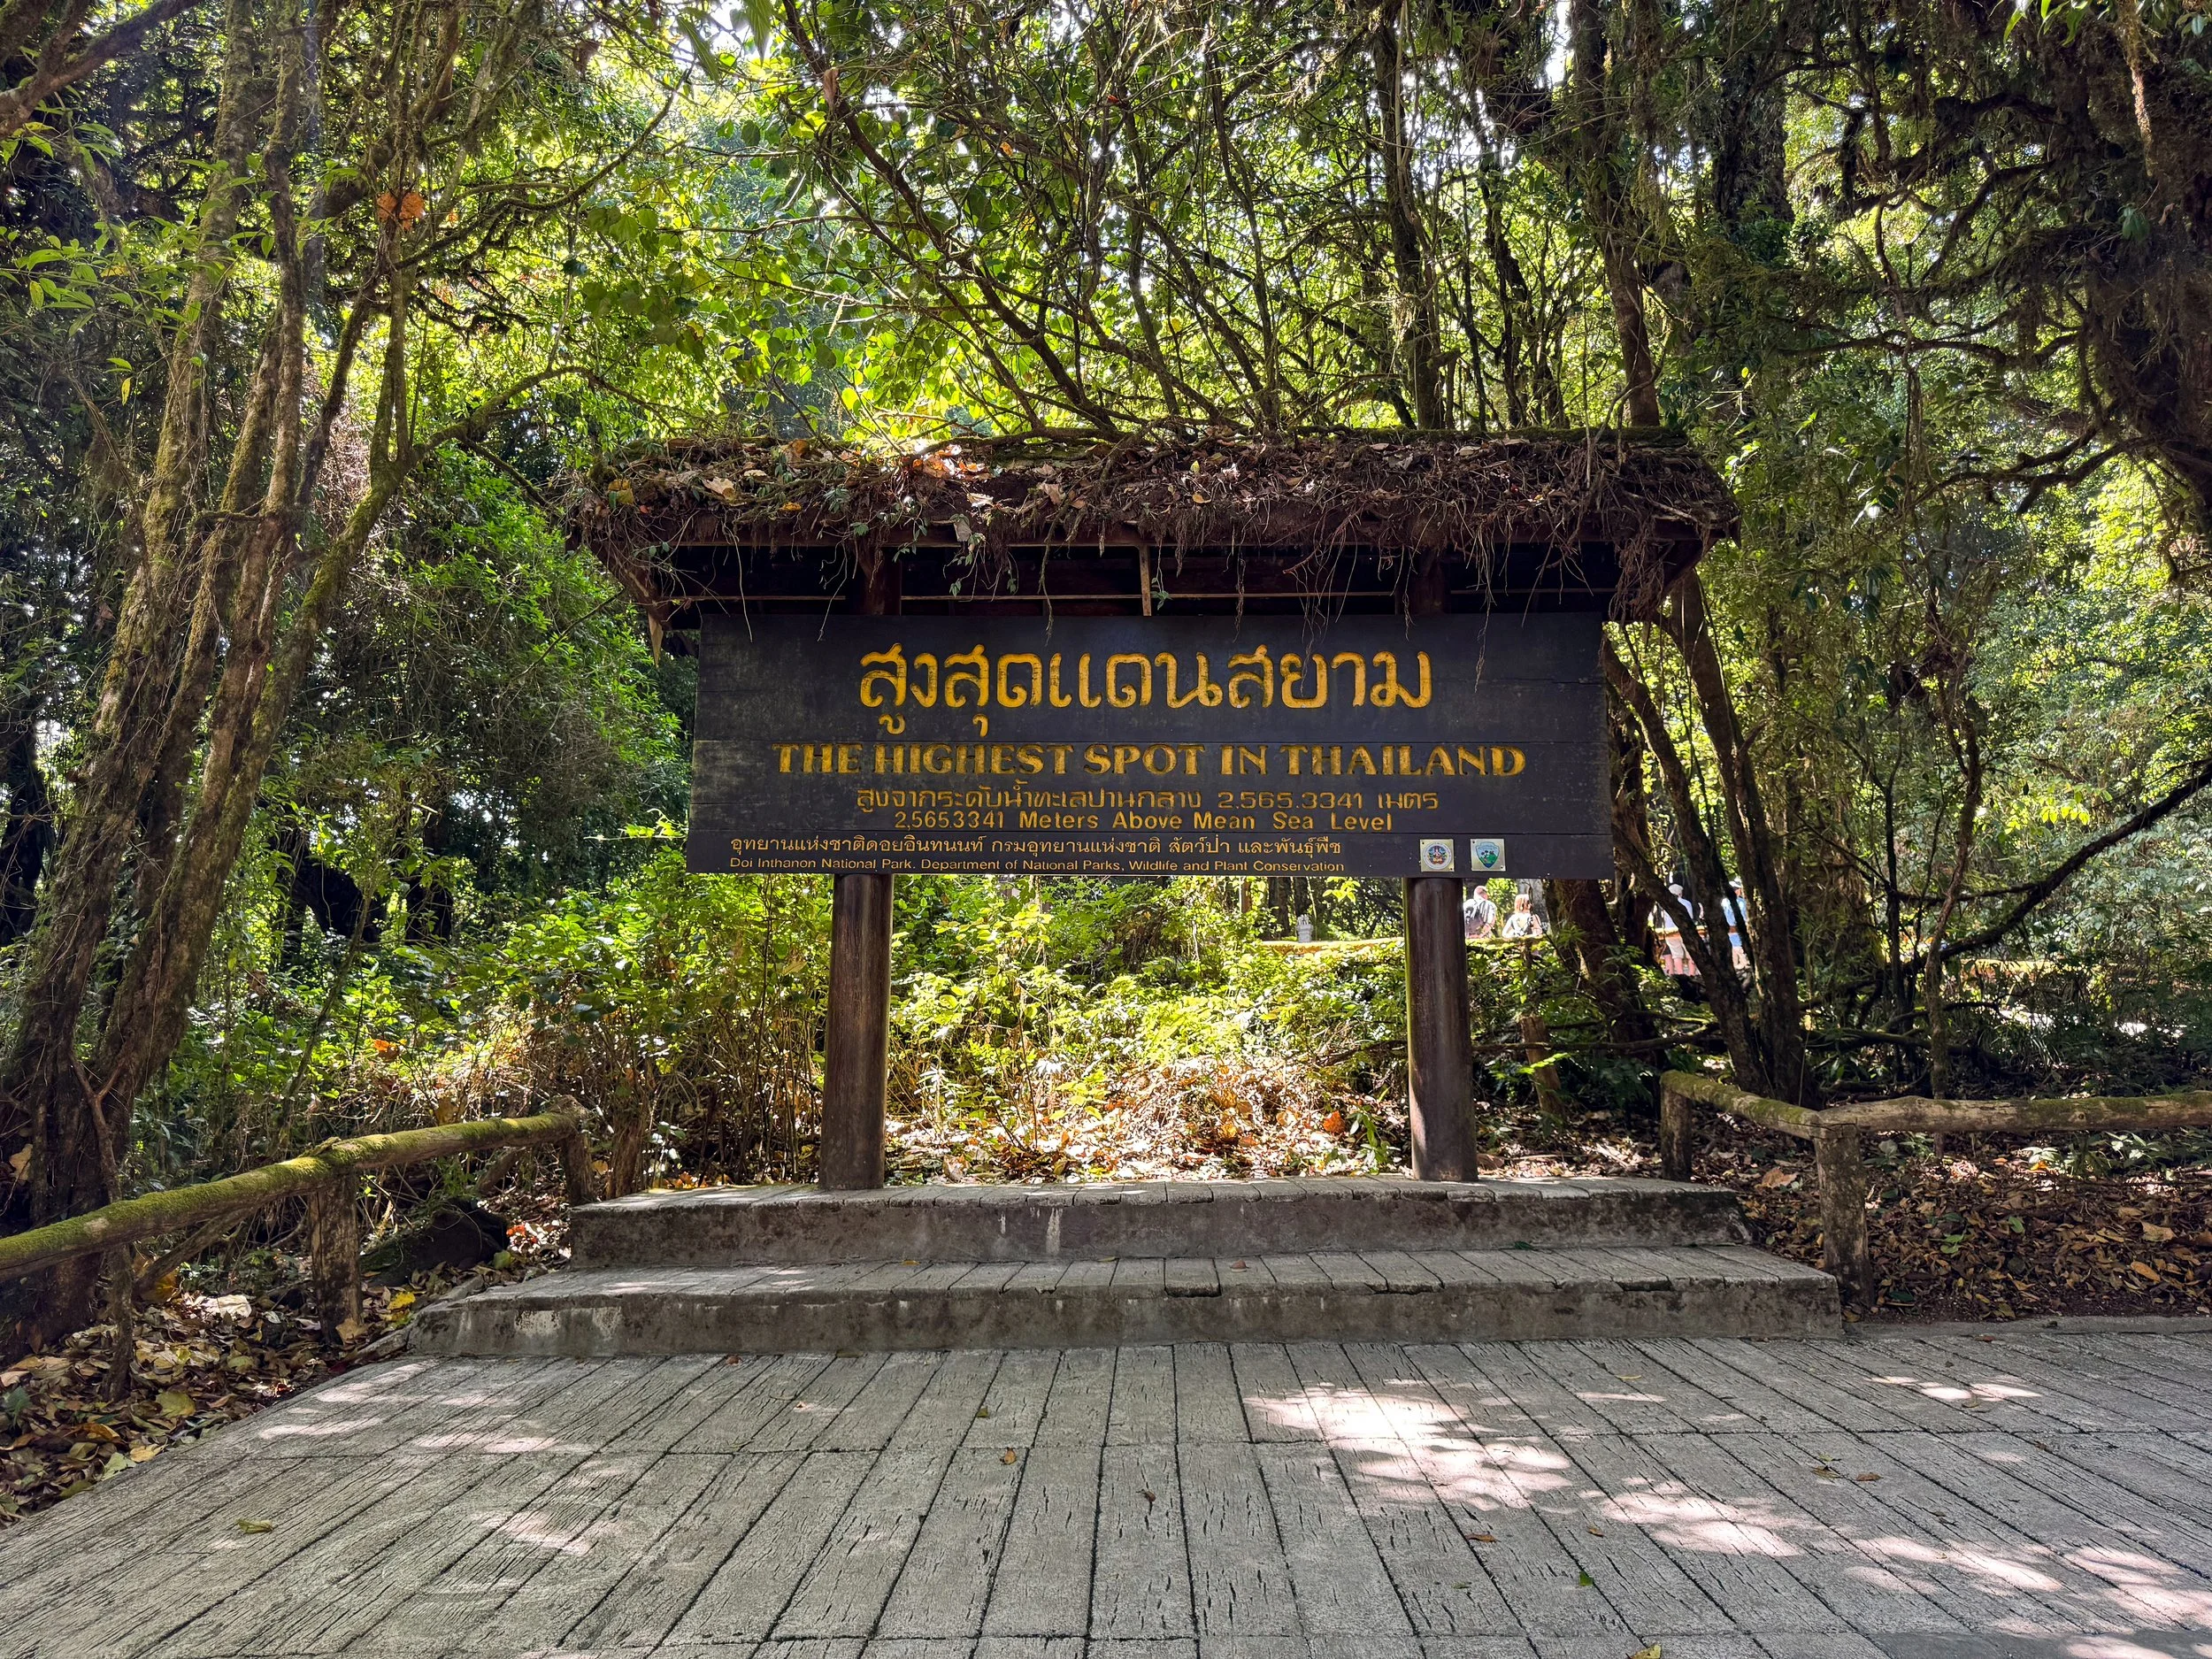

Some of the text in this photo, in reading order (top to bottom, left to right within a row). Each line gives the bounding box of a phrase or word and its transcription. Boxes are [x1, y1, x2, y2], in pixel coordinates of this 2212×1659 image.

[860, 643, 1432, 738] สูงสุดแดนสยาม
[772, 743, 1525, 778] THE HIGHEST SPOT IN THAILAND
[857, 779, 1202, 812] สูงจากระดับน้ำทะเลปานกลาง
[1379, 793, 1439, 810] เมตร
[1019, 810, 1098, 828] Meters
[1112, 810, 1182, 829] Above
[1194, 811, 1255, 830] Mean
[1273, 810, 1314, 831] Sea
[1331, 810, 1392, 832] Level
[732, 834, 1342, 858] อุทยานแห่งชาติดอยอินทนนท์ กรมอุทยานแห่งชาติ สัตว์ป่า และพันธุ์พืช
[729, 857, 753, 869] Doi
[757, 857, 817, 869] Inthanon
[821, 858, 877, 870] National
[921, 859, 1001, 872] Department
[1004, 859, 1018, 870] of
[1023, 859, 1079, 871] National
[1083, 860, 1125, 872] Parks,
[1129, 860, 1179, 872] Wildlife
[1183, 861, 1210, 872] and
[1215, 861, 1248, 872] Plant
[1253, 860, 1345, 872] Conservation
